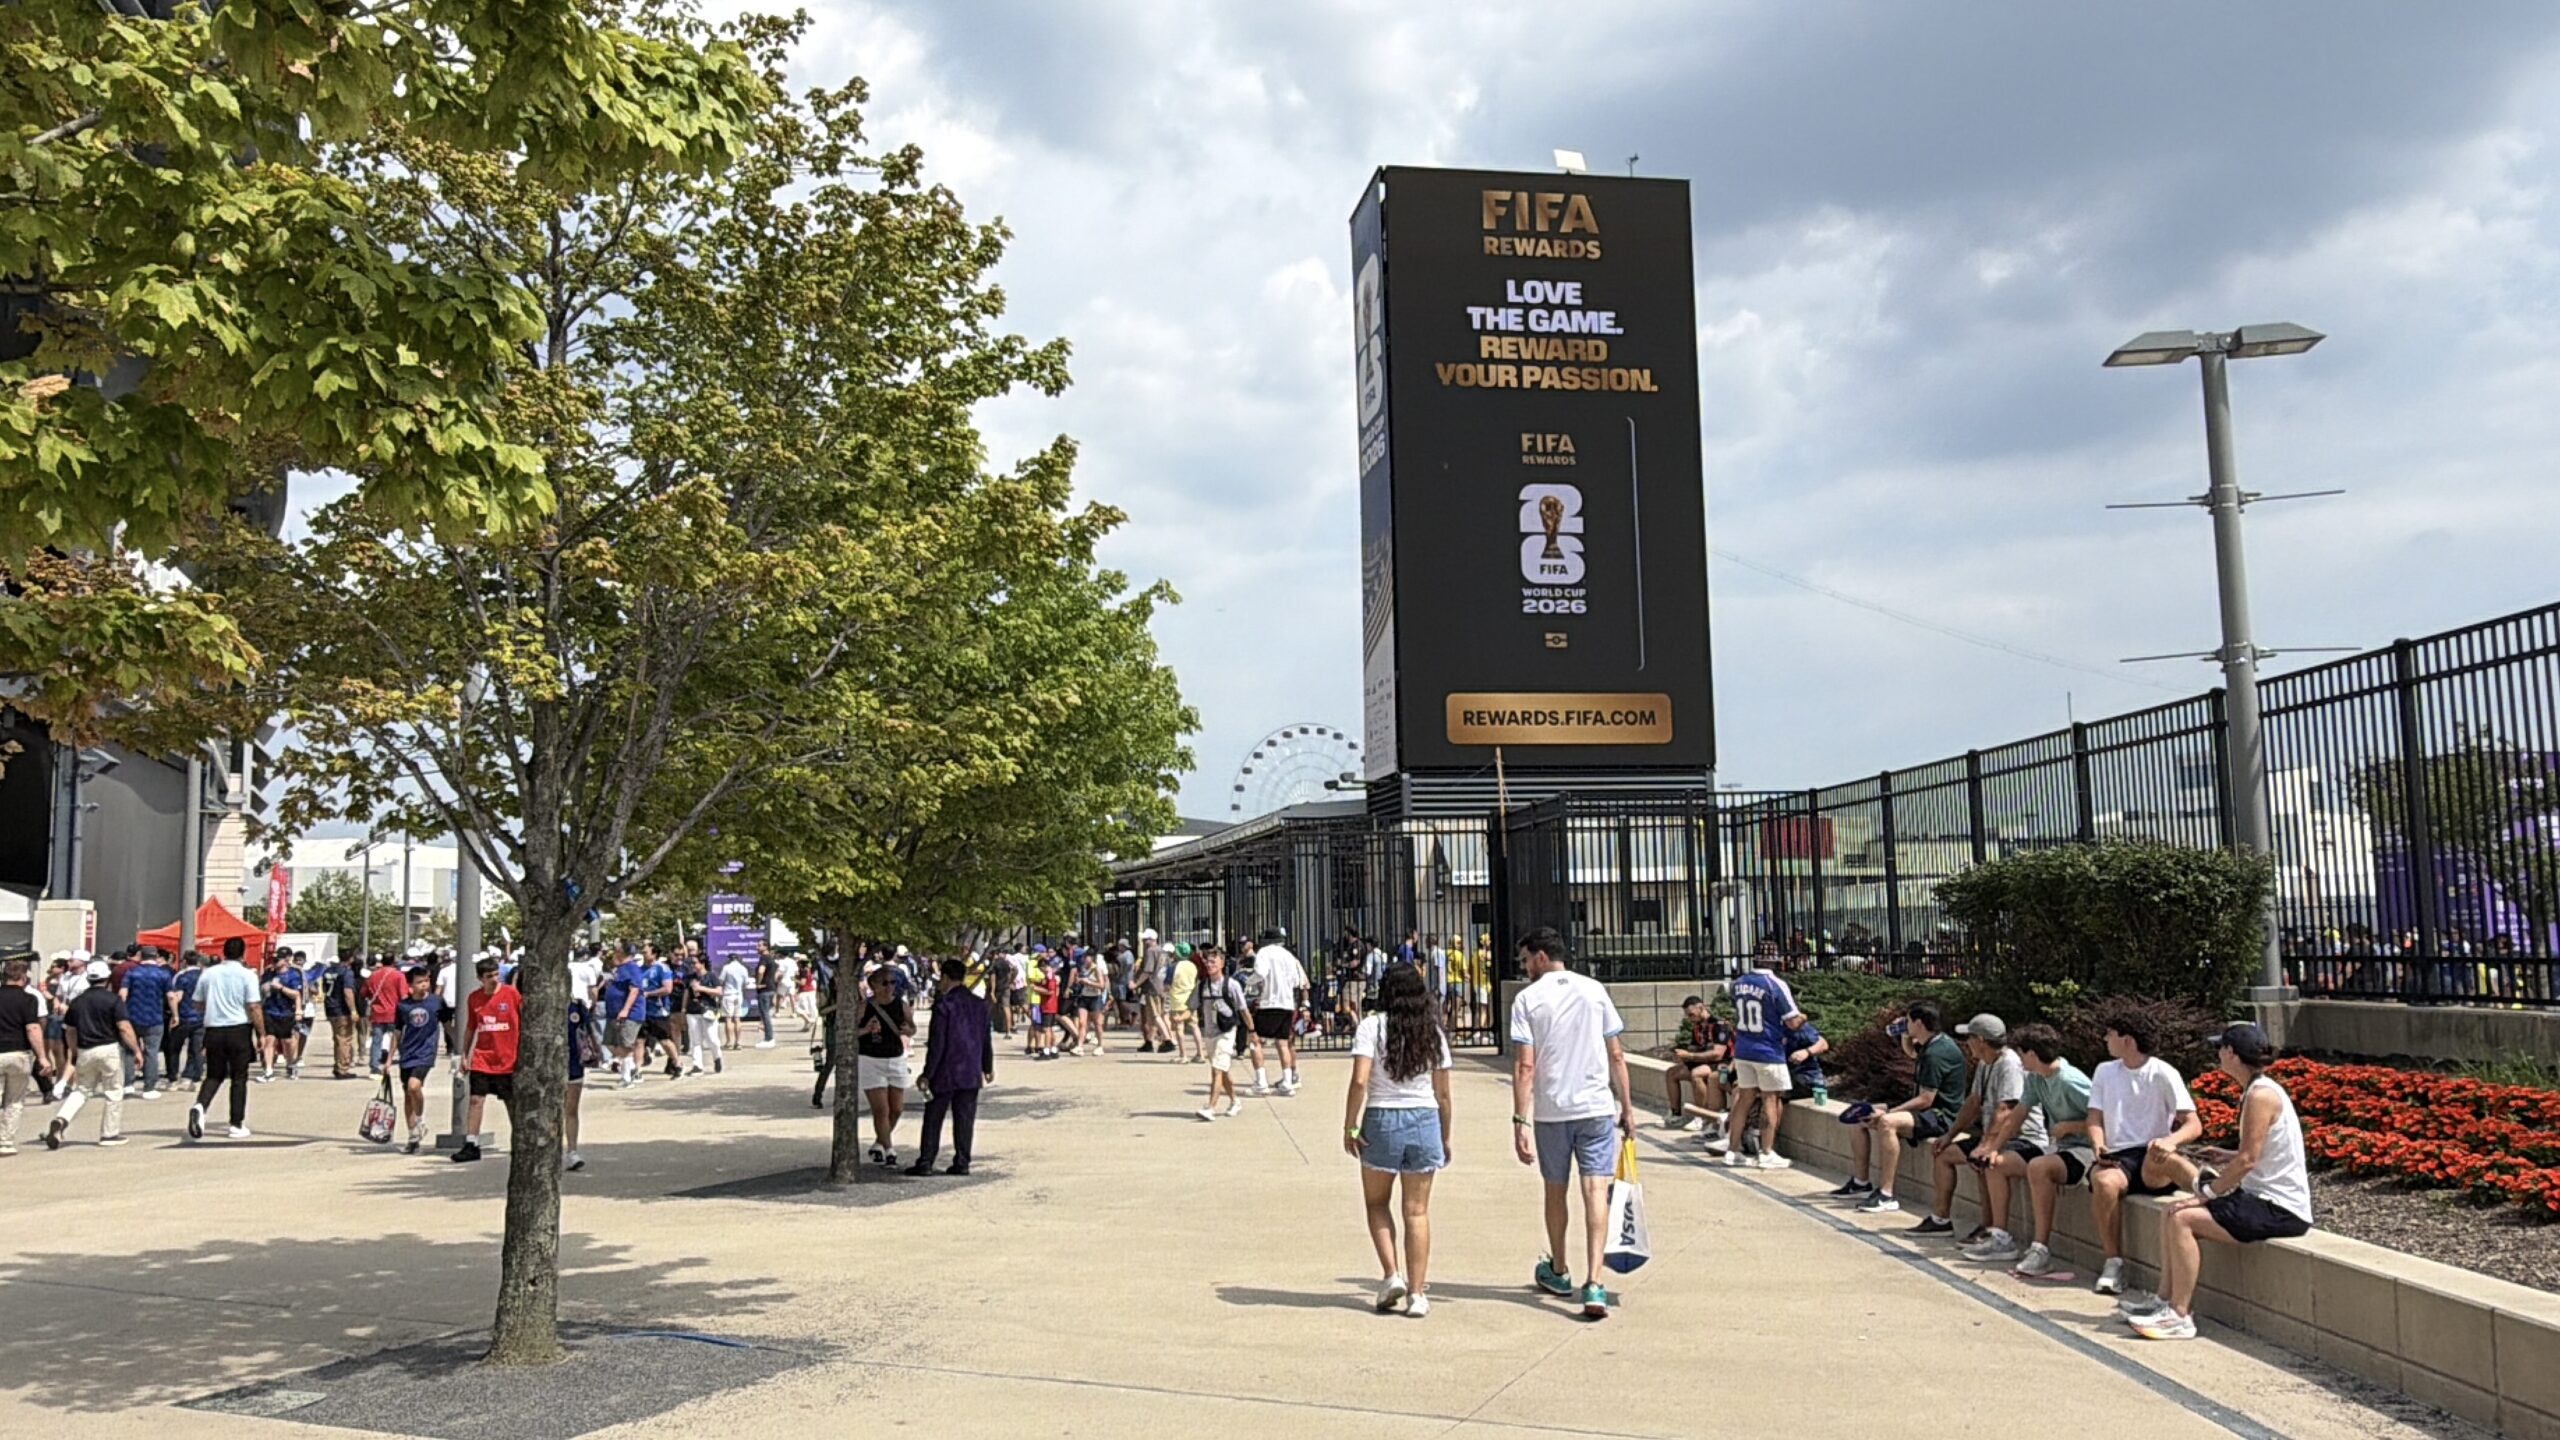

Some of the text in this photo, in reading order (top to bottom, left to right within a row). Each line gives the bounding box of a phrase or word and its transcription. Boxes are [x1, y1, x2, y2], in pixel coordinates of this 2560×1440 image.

[1482, 190, 1600, 234] FIFA
[1484, 236, 1601, 259] REWARDS
[1506, 279, 1582, 305] LOVE
[1467, 306, 1624, 335] THE GAME.
[1480, 335, 1607, 361] REWARD
[1436, 363, 1658, 392] YOUR PASSION.
[1521, 433, 1575, 454] FIFA
[1522, 455, 1576, 465] REWARDS
[1540, 564, 1568, 575] FIFA
[1521, 587, 1587, 597] WORLD CUP
[1522, 599, 1587, 614] 2026
[1463, 710, 1656, 726] REWARDS.FIFA.COM
[1736, 998, 1764, 1033] 10
[1619, 1201, 1636, 1246] VISA
